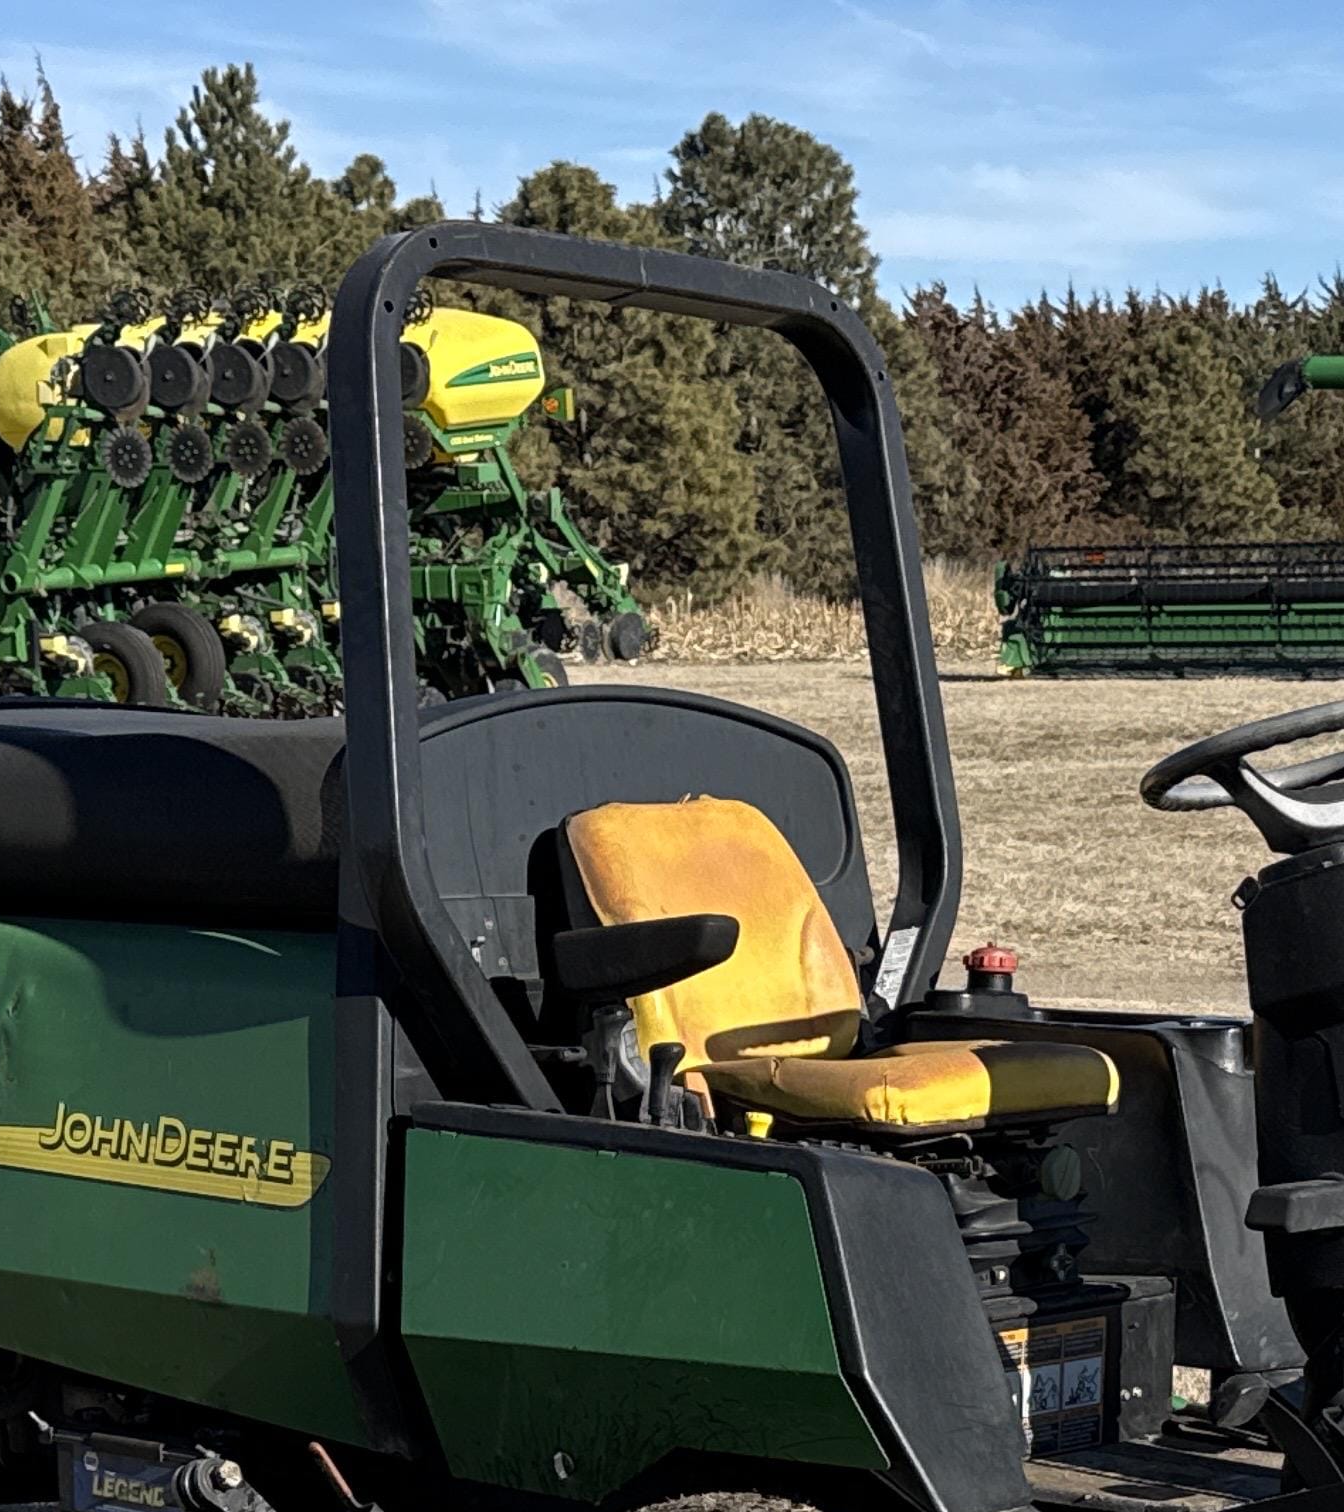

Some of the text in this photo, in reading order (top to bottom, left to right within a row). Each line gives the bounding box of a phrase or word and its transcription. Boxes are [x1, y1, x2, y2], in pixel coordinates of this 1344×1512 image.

[38, 1100, 294, 1184] JOHN DEERE
[92, 1472, 166, 1508] LEGEND
